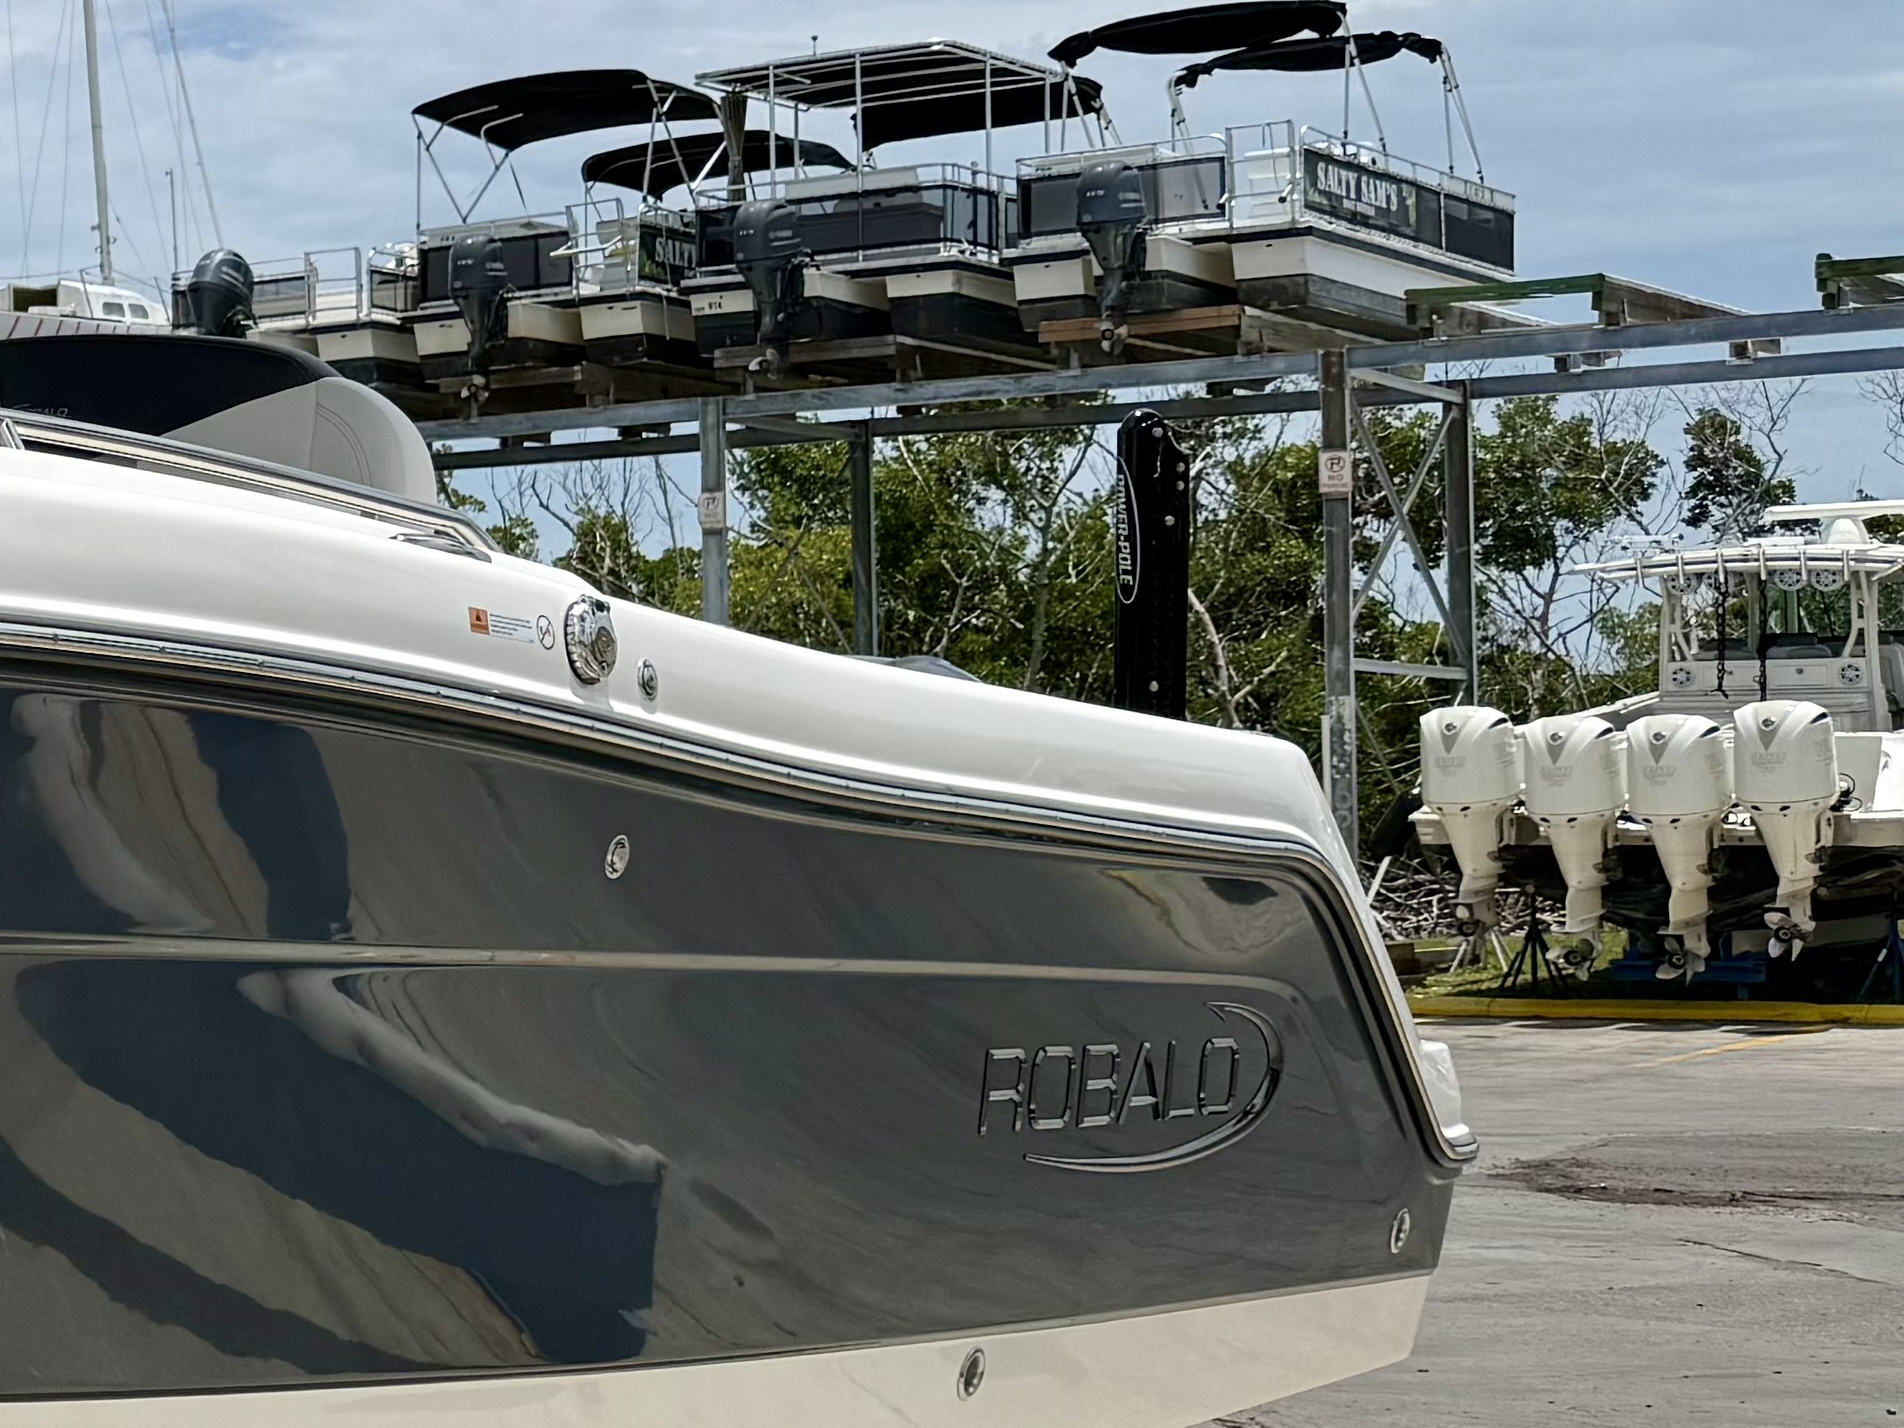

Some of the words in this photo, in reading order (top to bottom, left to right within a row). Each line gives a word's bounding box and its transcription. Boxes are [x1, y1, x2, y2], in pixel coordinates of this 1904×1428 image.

[1317, 162, 1357, 200] SALTY
[1361, 175, 1397, 211] SAM'S
[977, 1035, 1240, 1136] ROBALO
